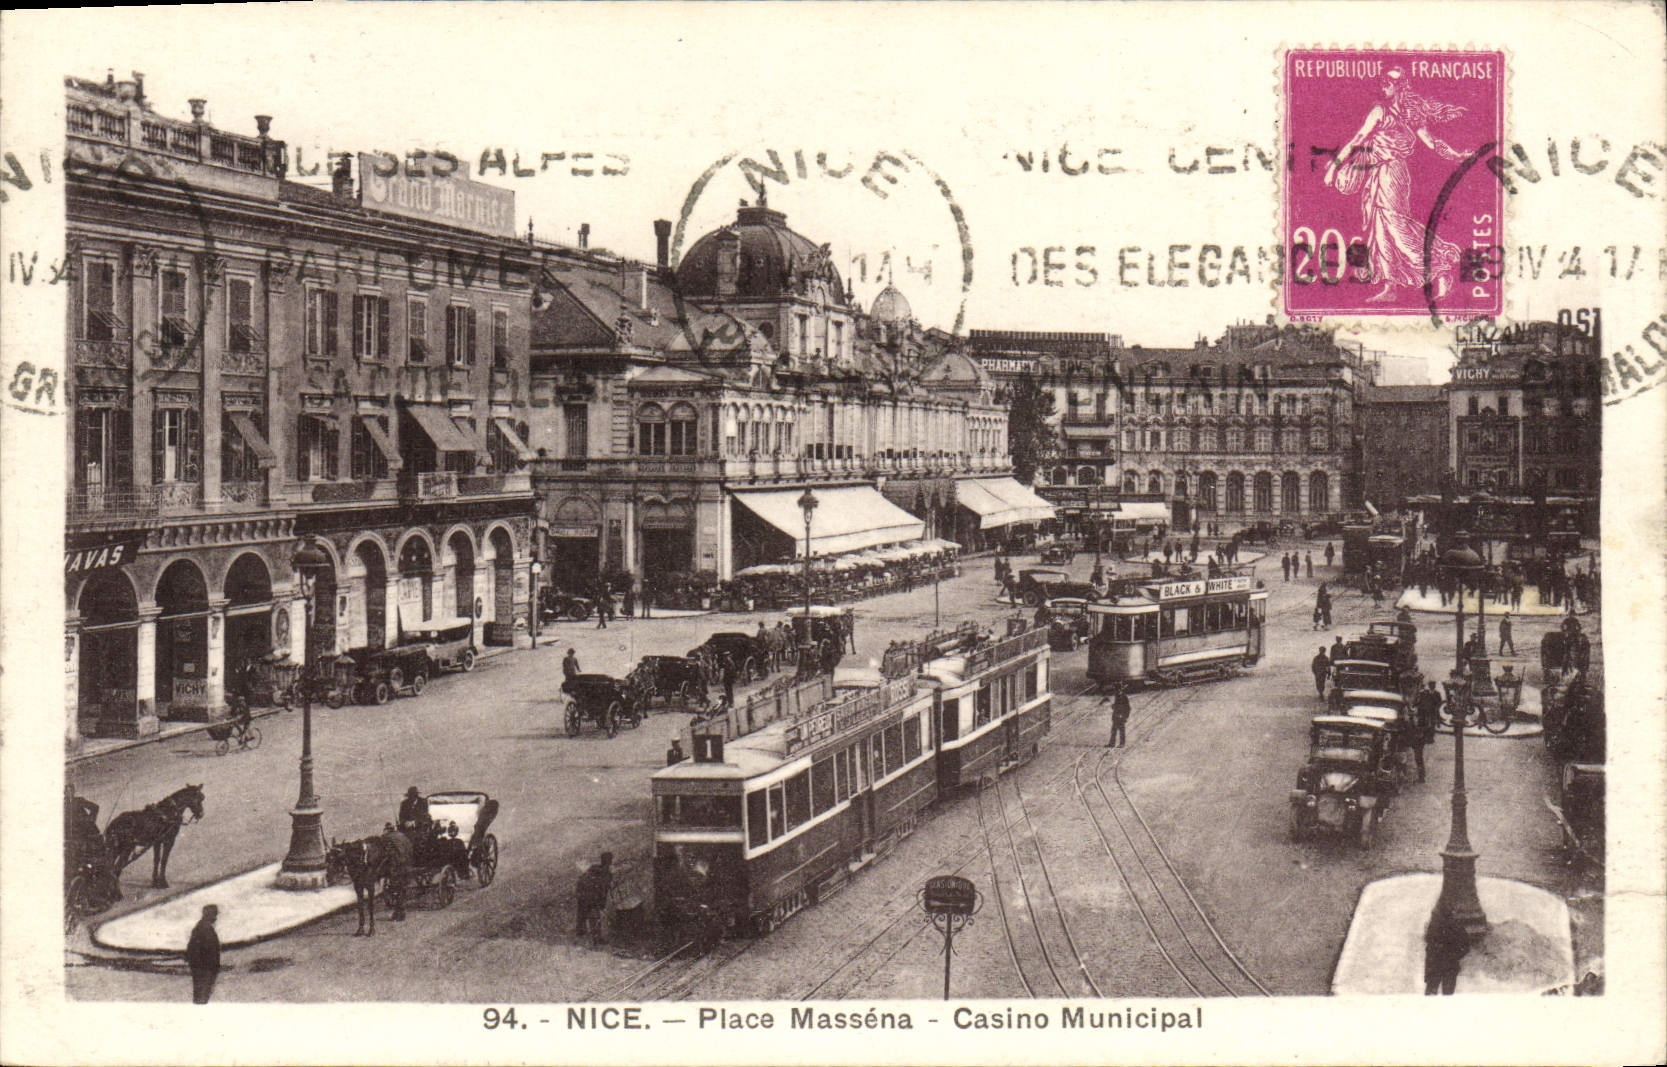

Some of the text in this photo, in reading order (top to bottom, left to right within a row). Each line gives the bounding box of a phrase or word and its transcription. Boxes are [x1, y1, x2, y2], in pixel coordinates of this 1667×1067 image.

[1455, 367, 1490, 380] VICHY
[1164, 583, 1191, 597] BLACK
[1208, 578, 1233, 591] WHITE
[175, 683, 207, 696] VICHY
[705, 738, 713, 759] 1
